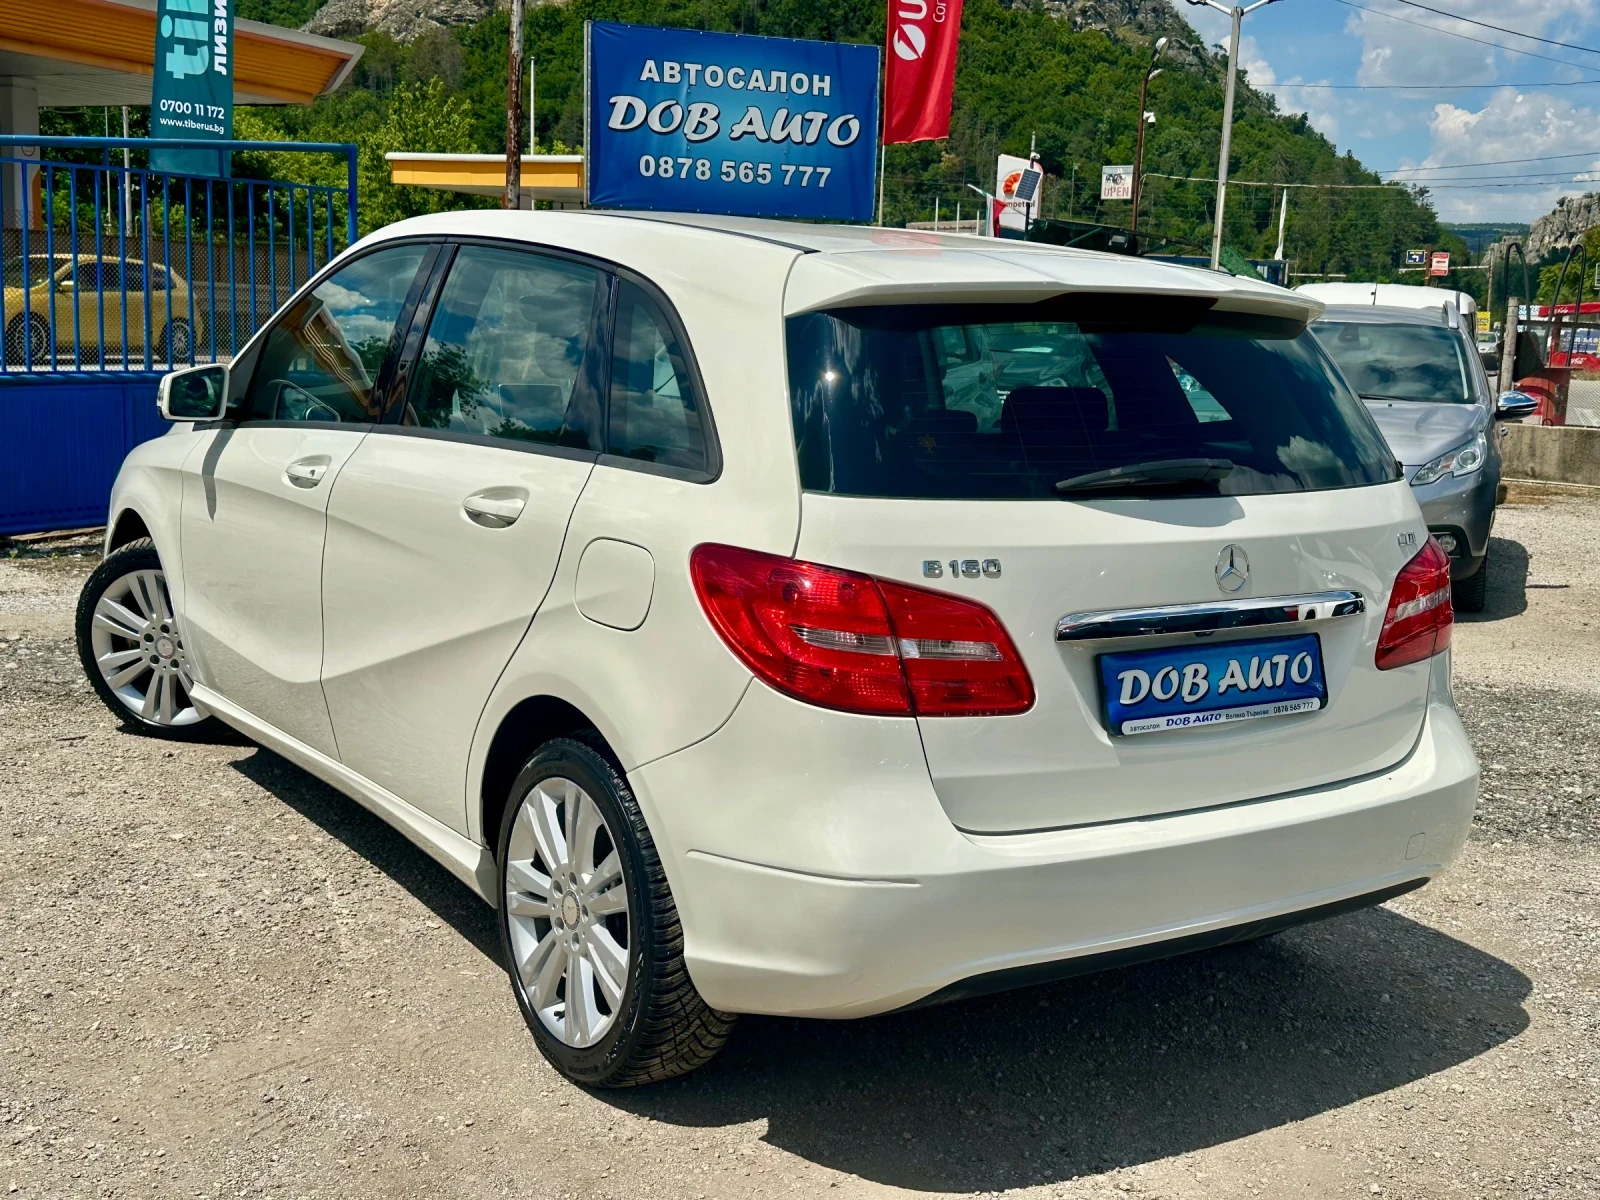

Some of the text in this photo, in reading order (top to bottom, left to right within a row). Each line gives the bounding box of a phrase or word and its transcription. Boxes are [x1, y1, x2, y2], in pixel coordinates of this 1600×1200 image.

[639, 59, 832, 97] АВТОСАЛОН
[160, 99, 225, 120] 0700 11 172
[160, 117, 225, 135] www.tiberus.bg
[607, 95, 861, 147] DOB AUTO
[638, 154, 832, 188] 0878 565 777
[1117, 651, 1314, 706] DOB AUTO
[1165, 716, 1191, 727] DOB
[1193, 713, 1222, 724] AUTO
[1302, 701, 1314, 709] 777
